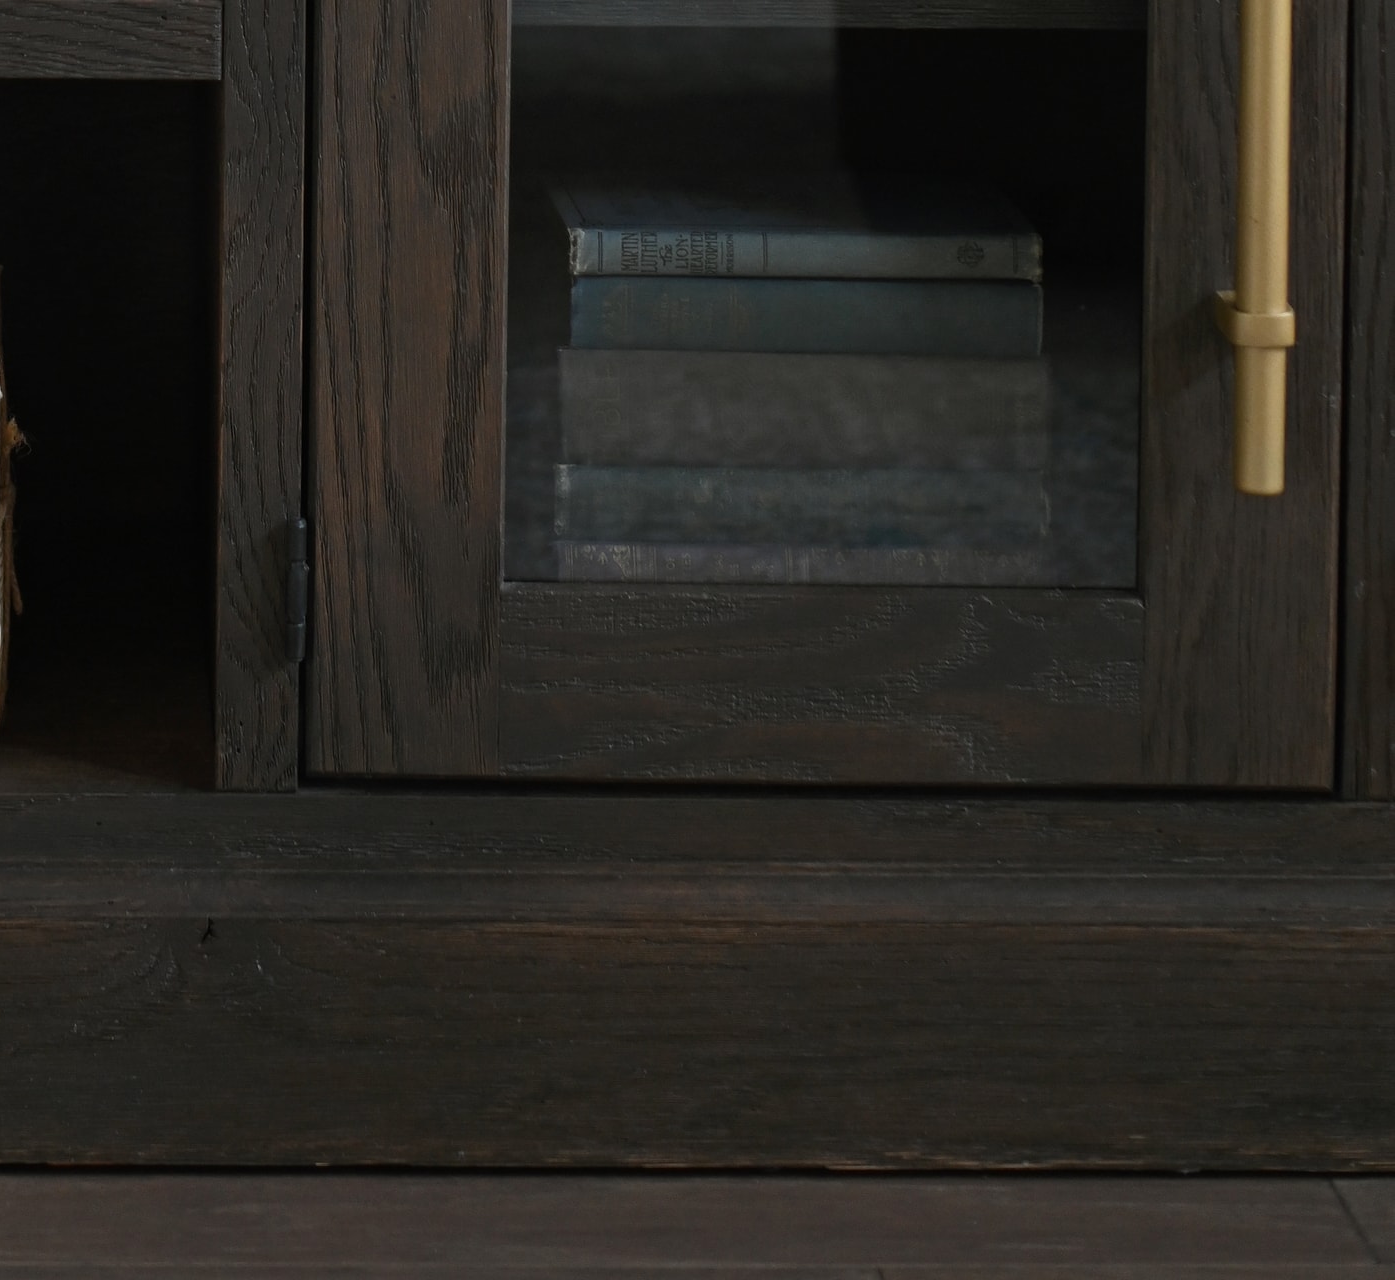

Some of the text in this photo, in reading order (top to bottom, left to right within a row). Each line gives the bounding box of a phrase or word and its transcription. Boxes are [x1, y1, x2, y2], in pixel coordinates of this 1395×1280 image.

[621, 231, 640, 273] MARTIN
[640, 230, 658, 274] LUTHER
[659, 243, 673, 266] The
[675, 234, 689, 269] LION-
[689, 230, 703, 274] HEARTED
[704, 230, 718, 276] REFORMER
